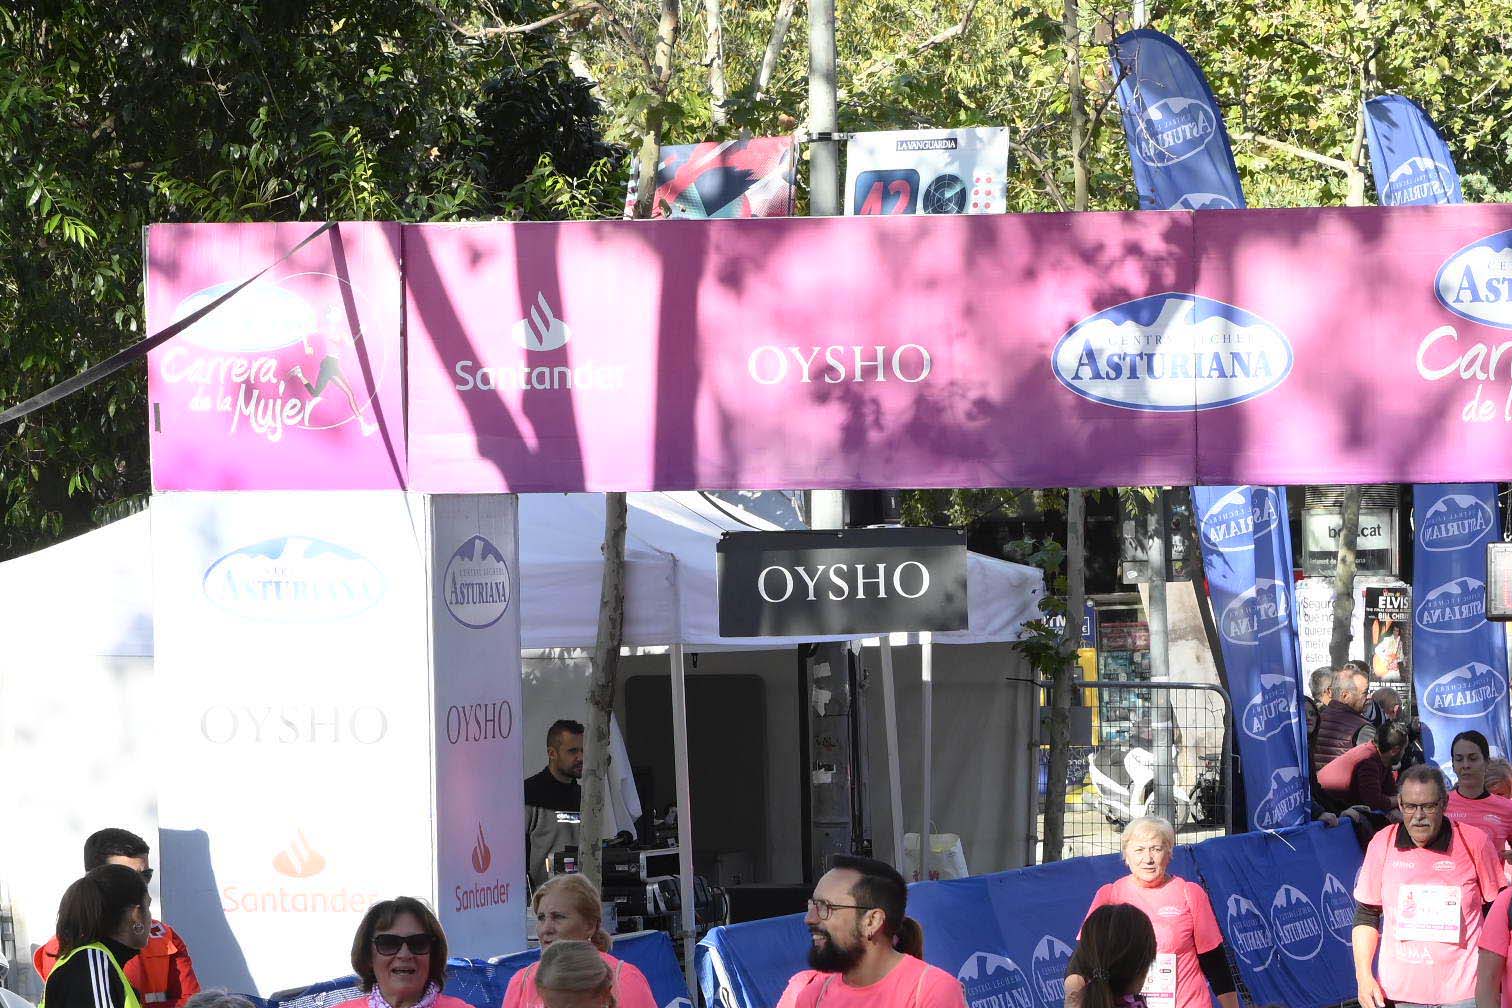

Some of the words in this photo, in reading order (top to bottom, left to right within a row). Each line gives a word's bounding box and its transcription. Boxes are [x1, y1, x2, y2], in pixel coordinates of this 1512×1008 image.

[161, 347, 278, 385] Carrera
[455, 360, 625, 392] Santander
[748, 343, 932, 384] OYSHO
[1070, 338, 1273, 381] ASTURIANA
[230, 380, 322, 441] Mujer
[1463, 384, 1496, 422] de
[449, 575, 507, 606] ASTURIANA
[757, 560, 931, 604] OYSHO
[1378, 595, 1409, 609] ELVIS
[200, 704, 390, 745] OYSHO
[446, 700, 512, 745] OYSHO
[455, 879, 512, 913] Santander
